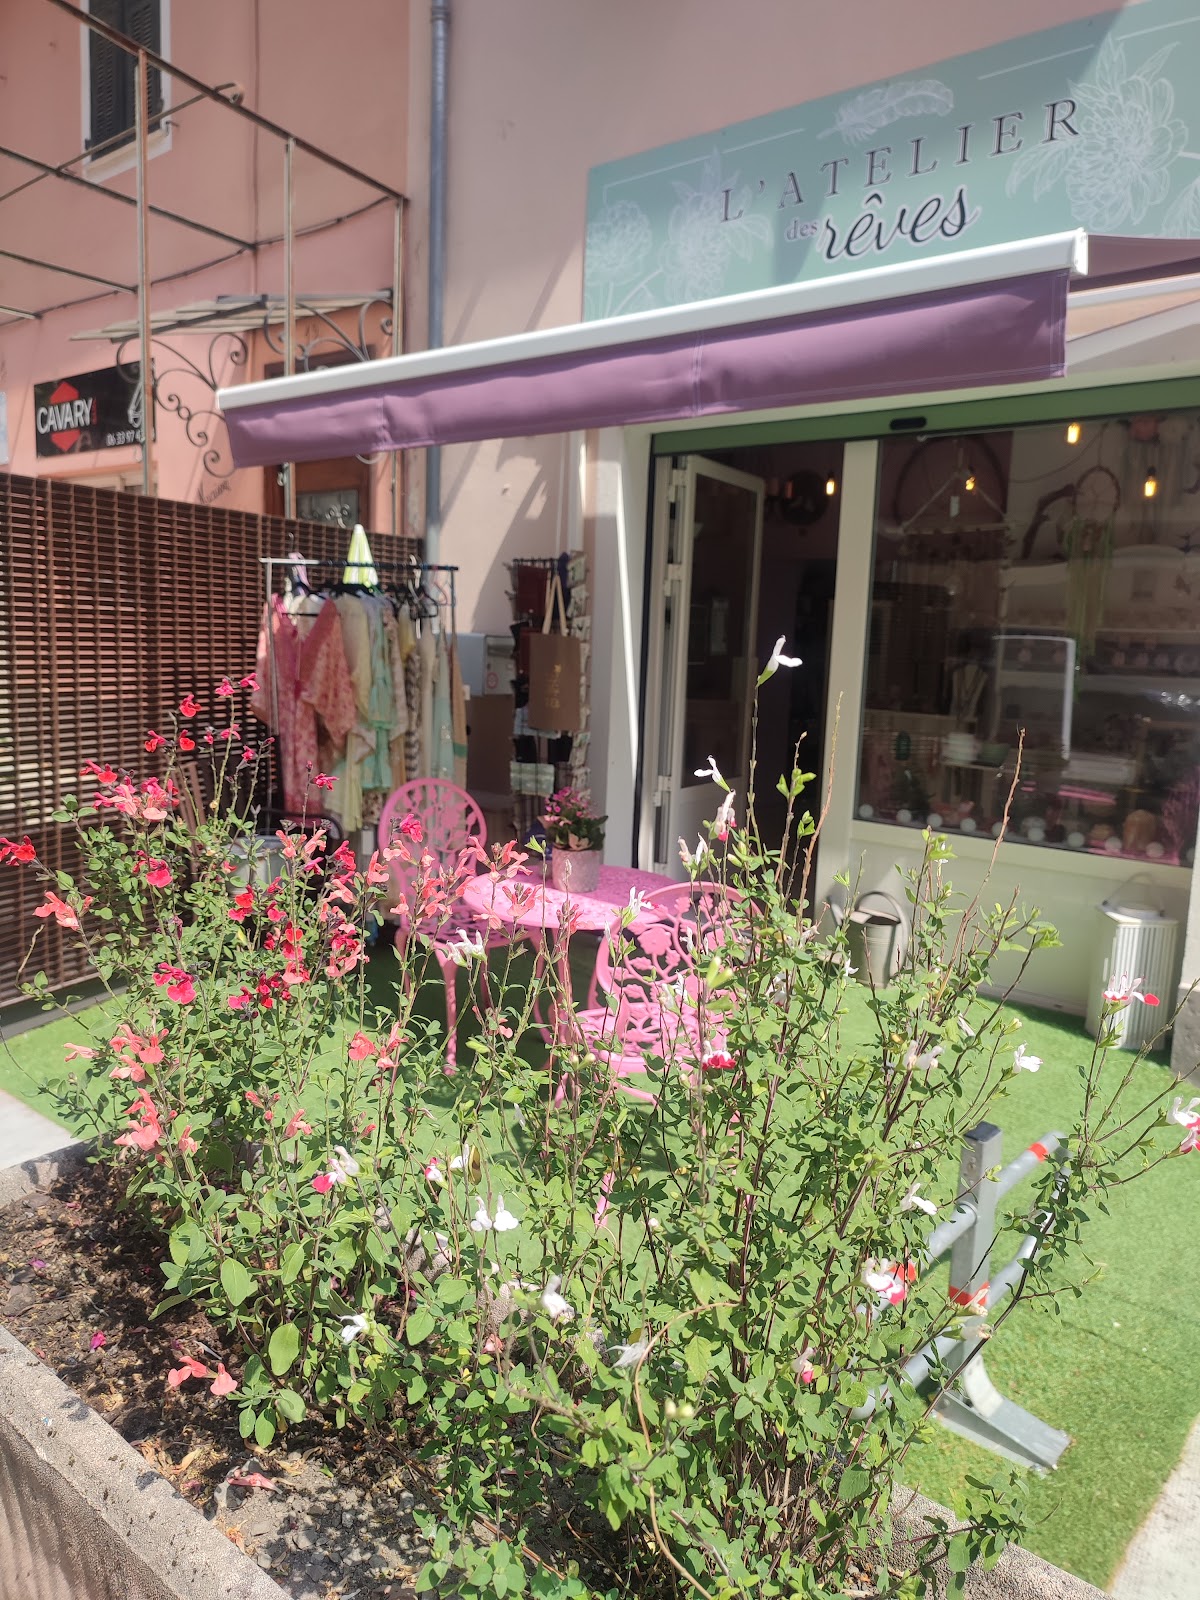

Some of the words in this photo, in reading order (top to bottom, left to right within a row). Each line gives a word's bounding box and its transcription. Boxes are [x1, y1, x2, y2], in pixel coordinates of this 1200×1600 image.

[721, 98, 1080, 223] L'ATELIER
[787, 219, 818, 240] des
[823, 185, 977, 260] rêves
[37, 398, 93, 434] CAVARY
